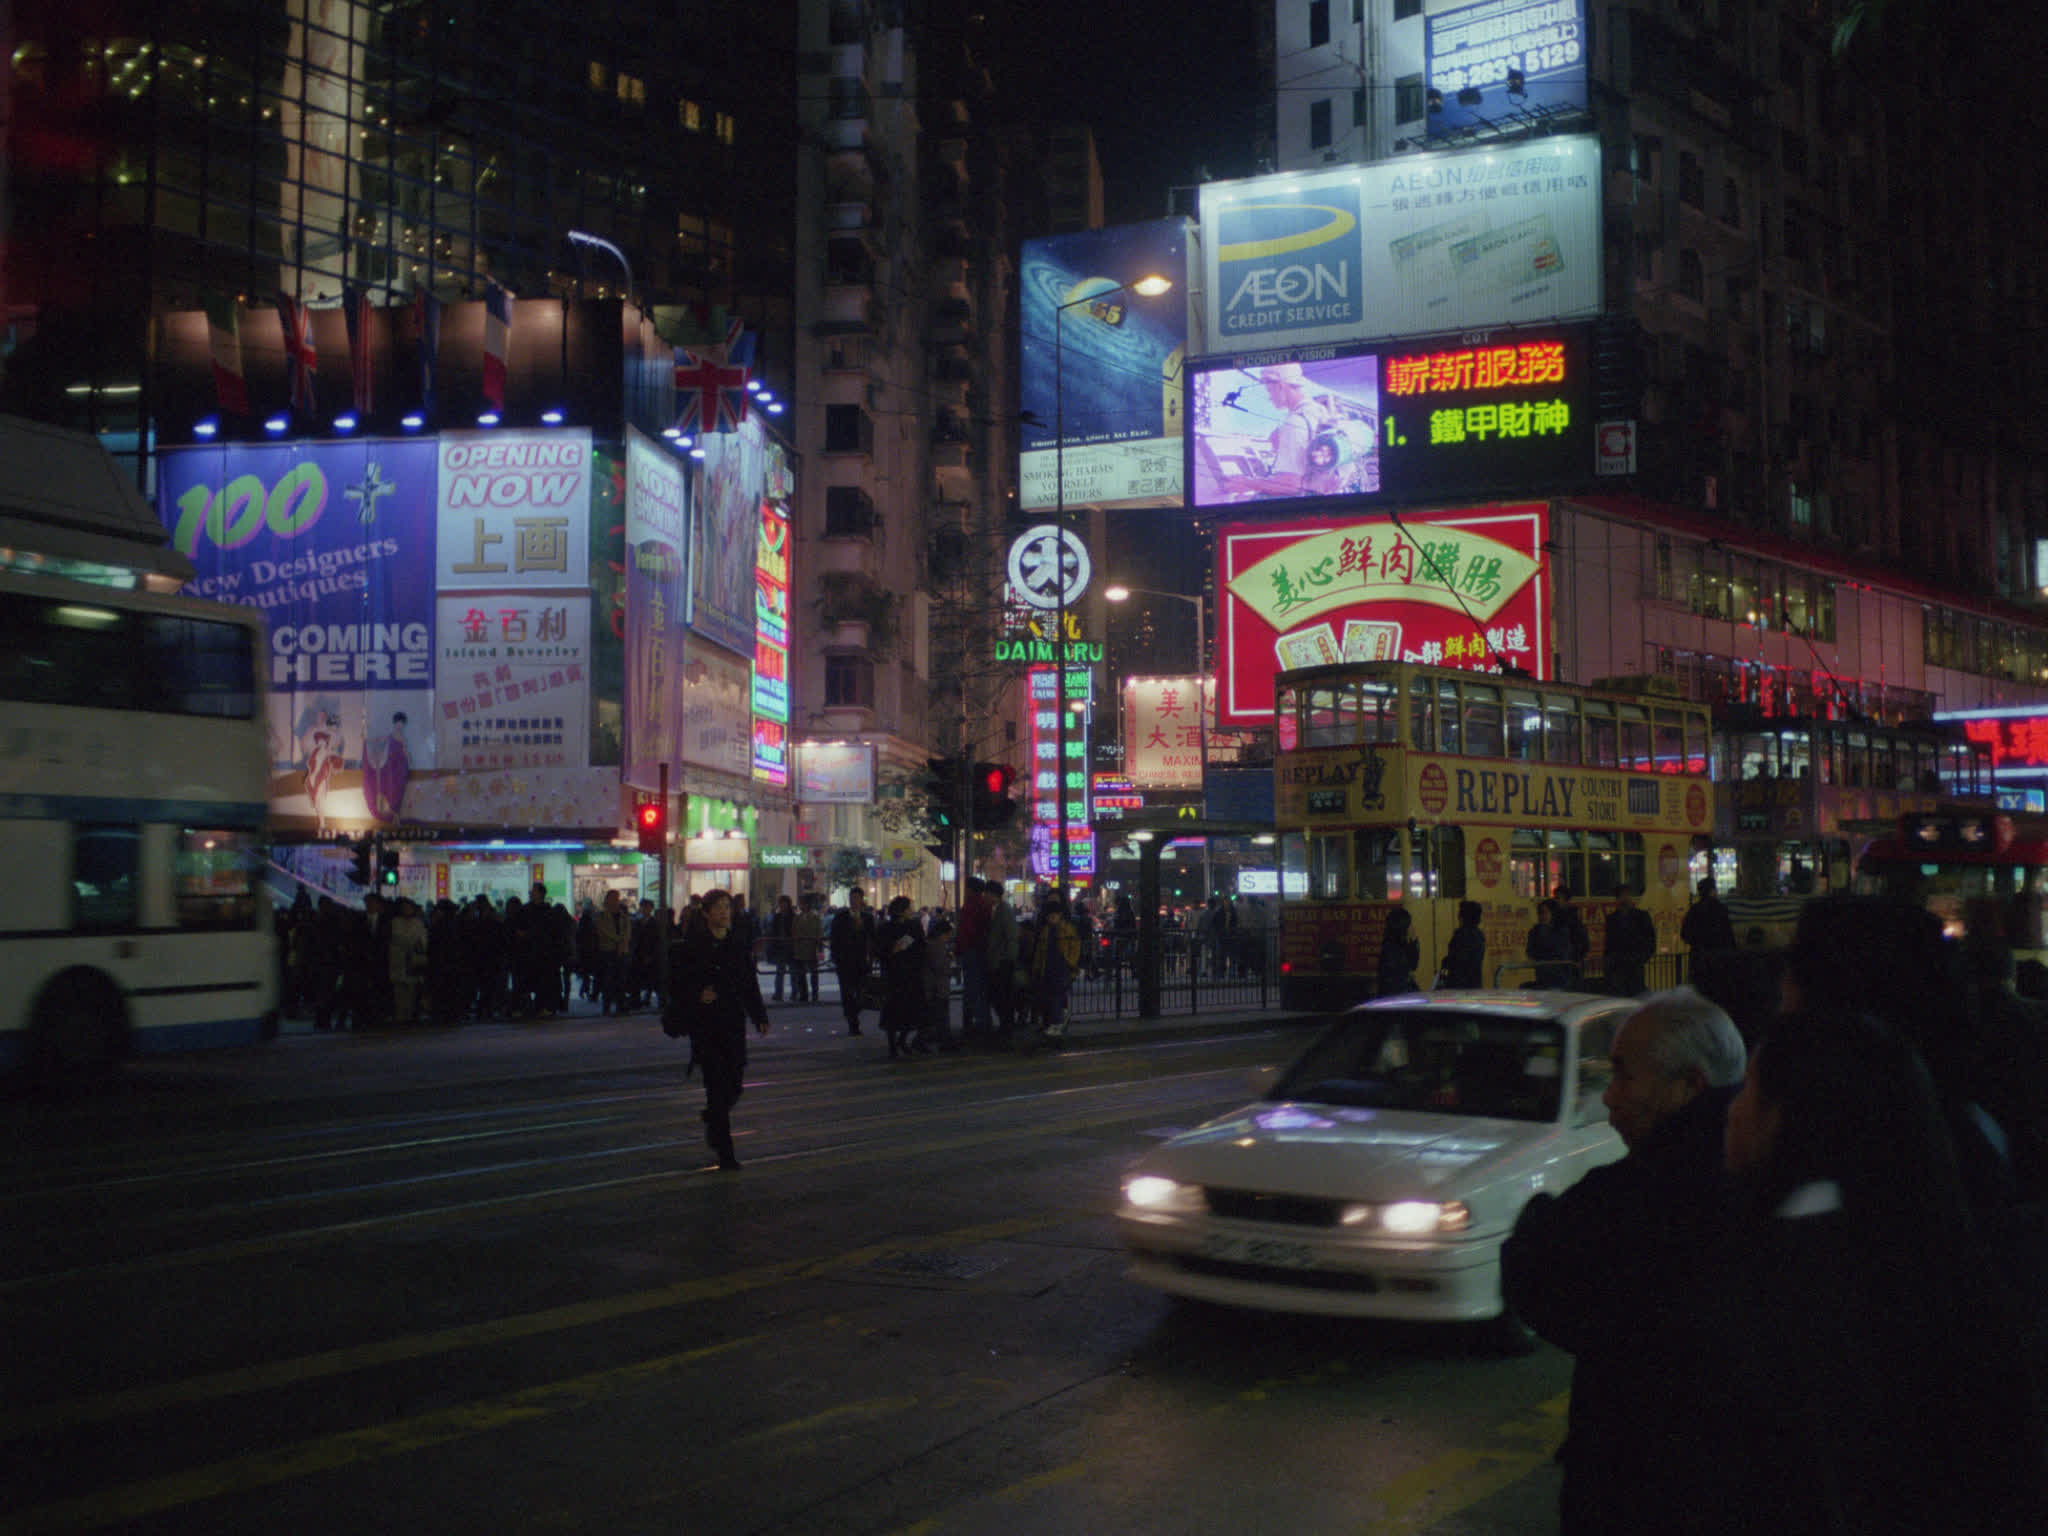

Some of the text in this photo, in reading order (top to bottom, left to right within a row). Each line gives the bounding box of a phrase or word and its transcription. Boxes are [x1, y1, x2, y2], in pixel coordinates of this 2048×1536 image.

[1525, 40, 1580, 72] 5129
[1391, 167, 1462, 192] AEON
[1228, 302, 1352, 329] CREDIT SERVICE
[1384, 398, 1570, 447] 1. 鐵甲財神
[445, 442, 583, 471] OPENING
[449, 472, 581, 508] NOW
[173, 461, 328, 559] 100
[250, 537, 399, 586] Designers
[452, 516, 569, 574] 上画
[272, 621, 430, 655] COMING
[457, 607, 567, 643] 金百利
[272, 652, 430, 683] HERE
[1282, 761, 1362, 785] REPLAY
[1580, 776, 1623, 798] COUNTRY
[1456, 768, 1577, 818] REPLAY
[1587, 803, 1617, 822] STORE
